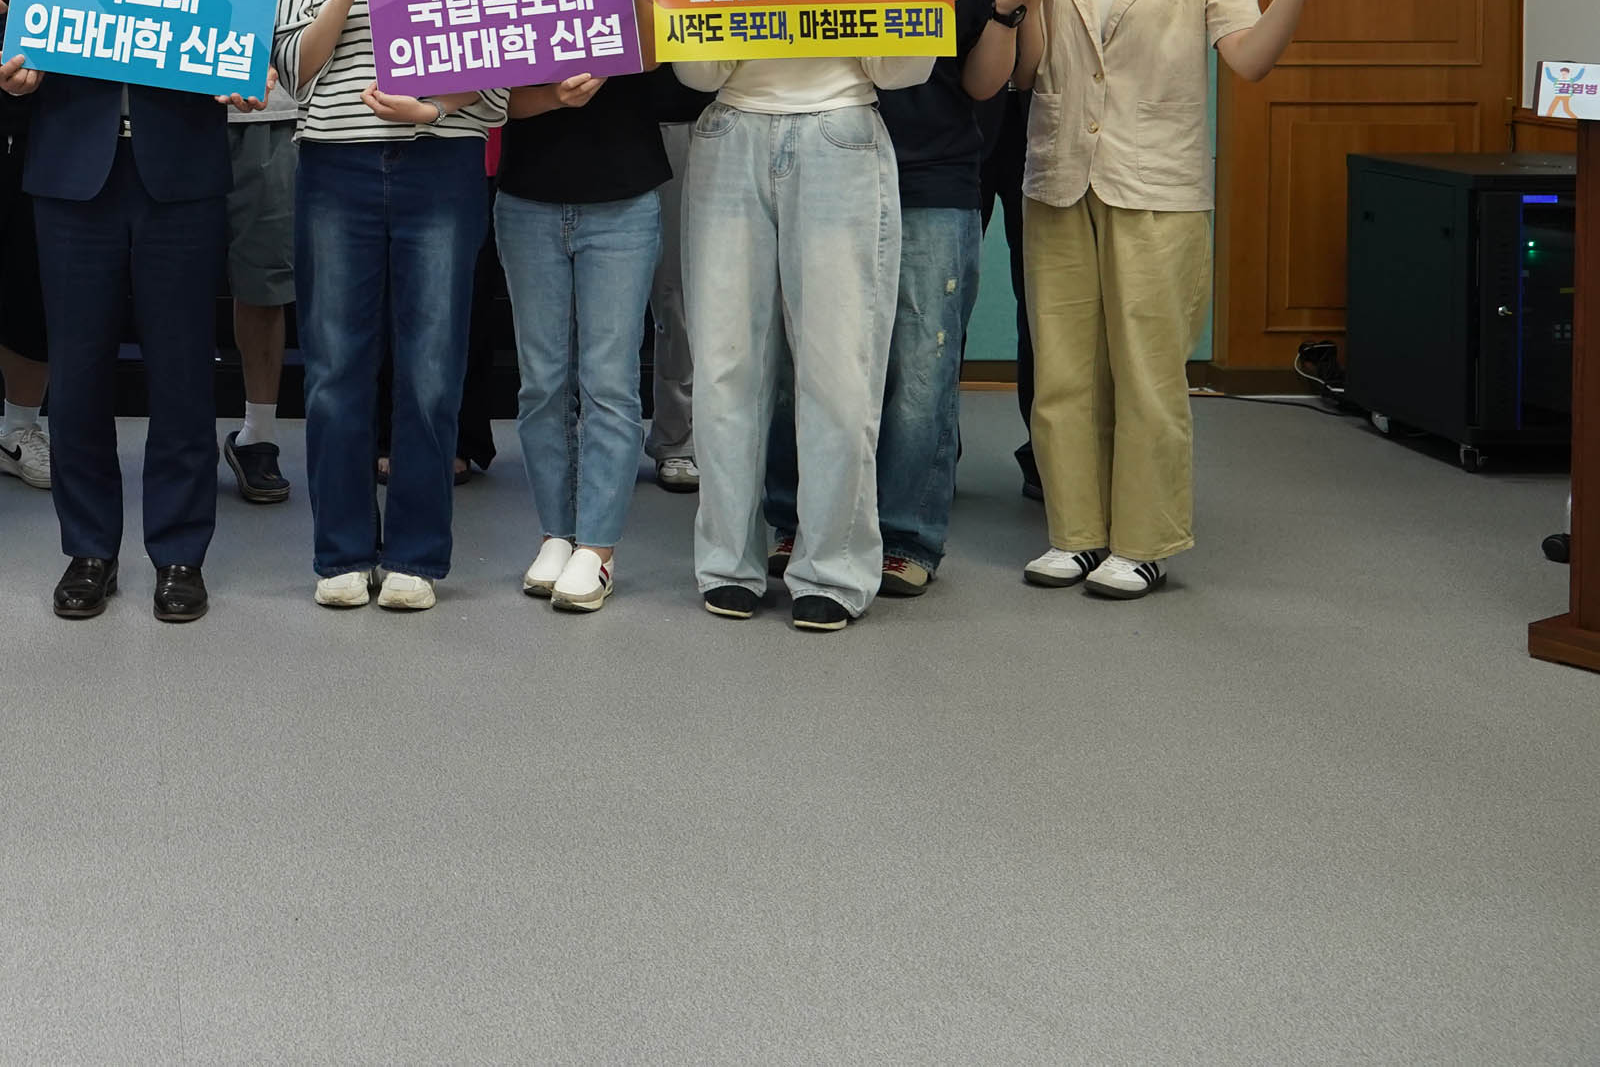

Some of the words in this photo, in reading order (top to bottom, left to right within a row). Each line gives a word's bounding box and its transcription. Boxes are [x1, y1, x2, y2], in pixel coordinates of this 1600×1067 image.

[20, 2, 173, 70] 의과대학
[179, 25, 256, 81] 신설
[389, 24, 537, 77] 의과대학
[550, 14, 625, 62] 신설
[667, 13, 724, 44] 시작도
[729, 10, 794, 45] 목포대,
[800, 8, 878, 40] 마침표도
[884, 7, 943, 39] 목포대
